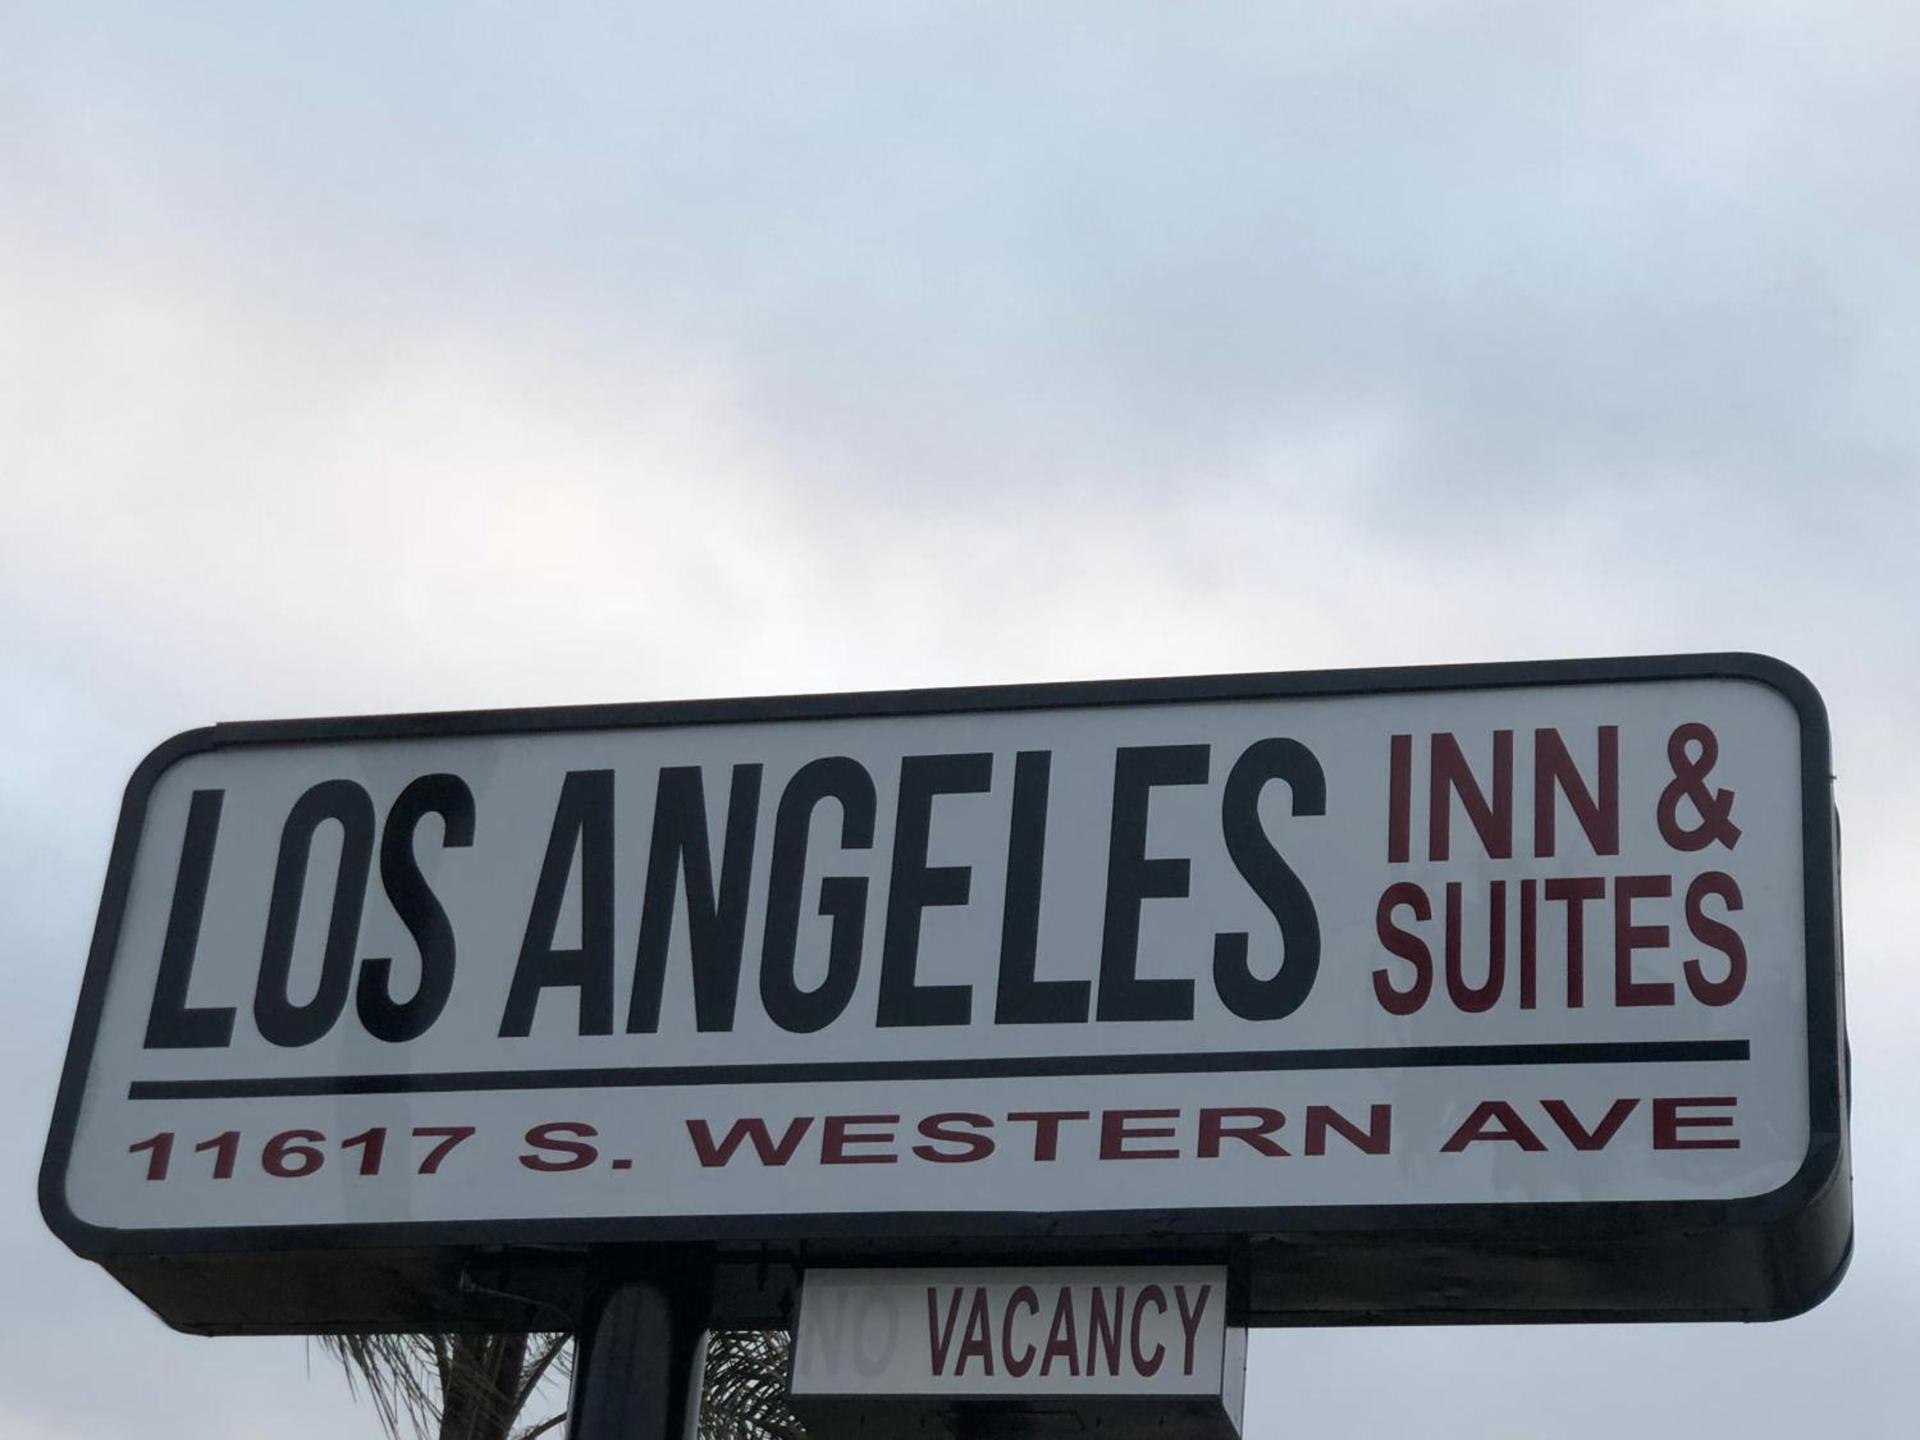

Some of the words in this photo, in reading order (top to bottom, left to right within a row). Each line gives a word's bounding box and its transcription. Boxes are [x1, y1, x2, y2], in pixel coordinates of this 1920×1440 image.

[1387, 725, 1620, 863] INN
[1656, 722, 1743, 852] &
[144, 773, 476, 1048] LOS
[498, 737, 1327, 1038] ANGELES
[1371, 870, 1749, 1016] SUITES
[128, 1126, 476, 1181] 11617
[519, 1122, 633, 1172] S.
[685, 1103, 1392, 1168] WESTERN
[1440, 1096, 1742, 1152] AVE
[800, 1284, 899, 1379] NO
[927, 1283, 1212, 1378] VACANCY
